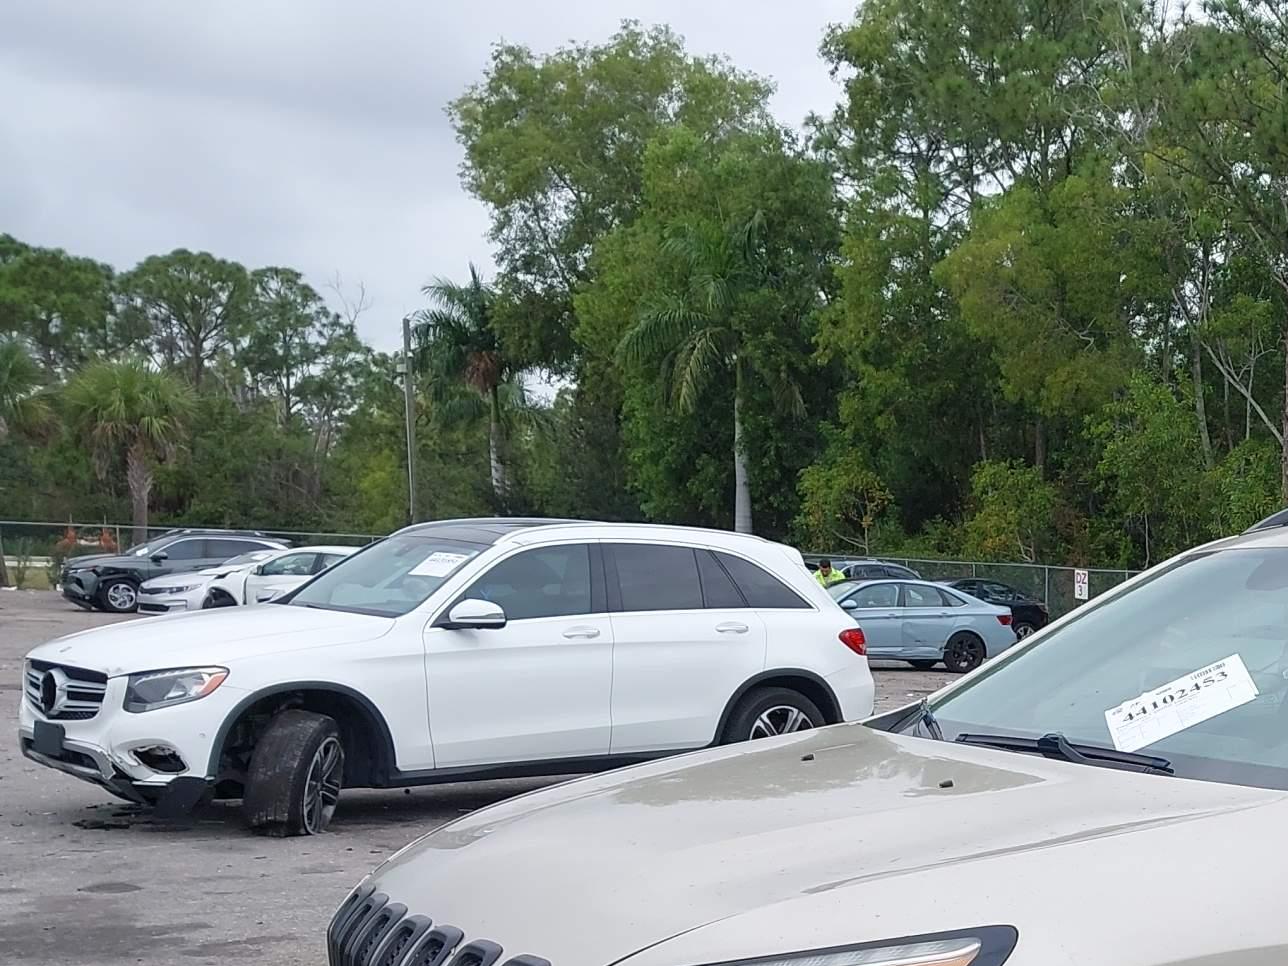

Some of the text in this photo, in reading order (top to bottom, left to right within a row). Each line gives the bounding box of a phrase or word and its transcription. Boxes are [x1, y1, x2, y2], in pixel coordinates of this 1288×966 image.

[1076, 572, 1087, 585] DZ
[1078, 585, 1083, 596] 3
[1122, 671, 1229, 722] 44102453
